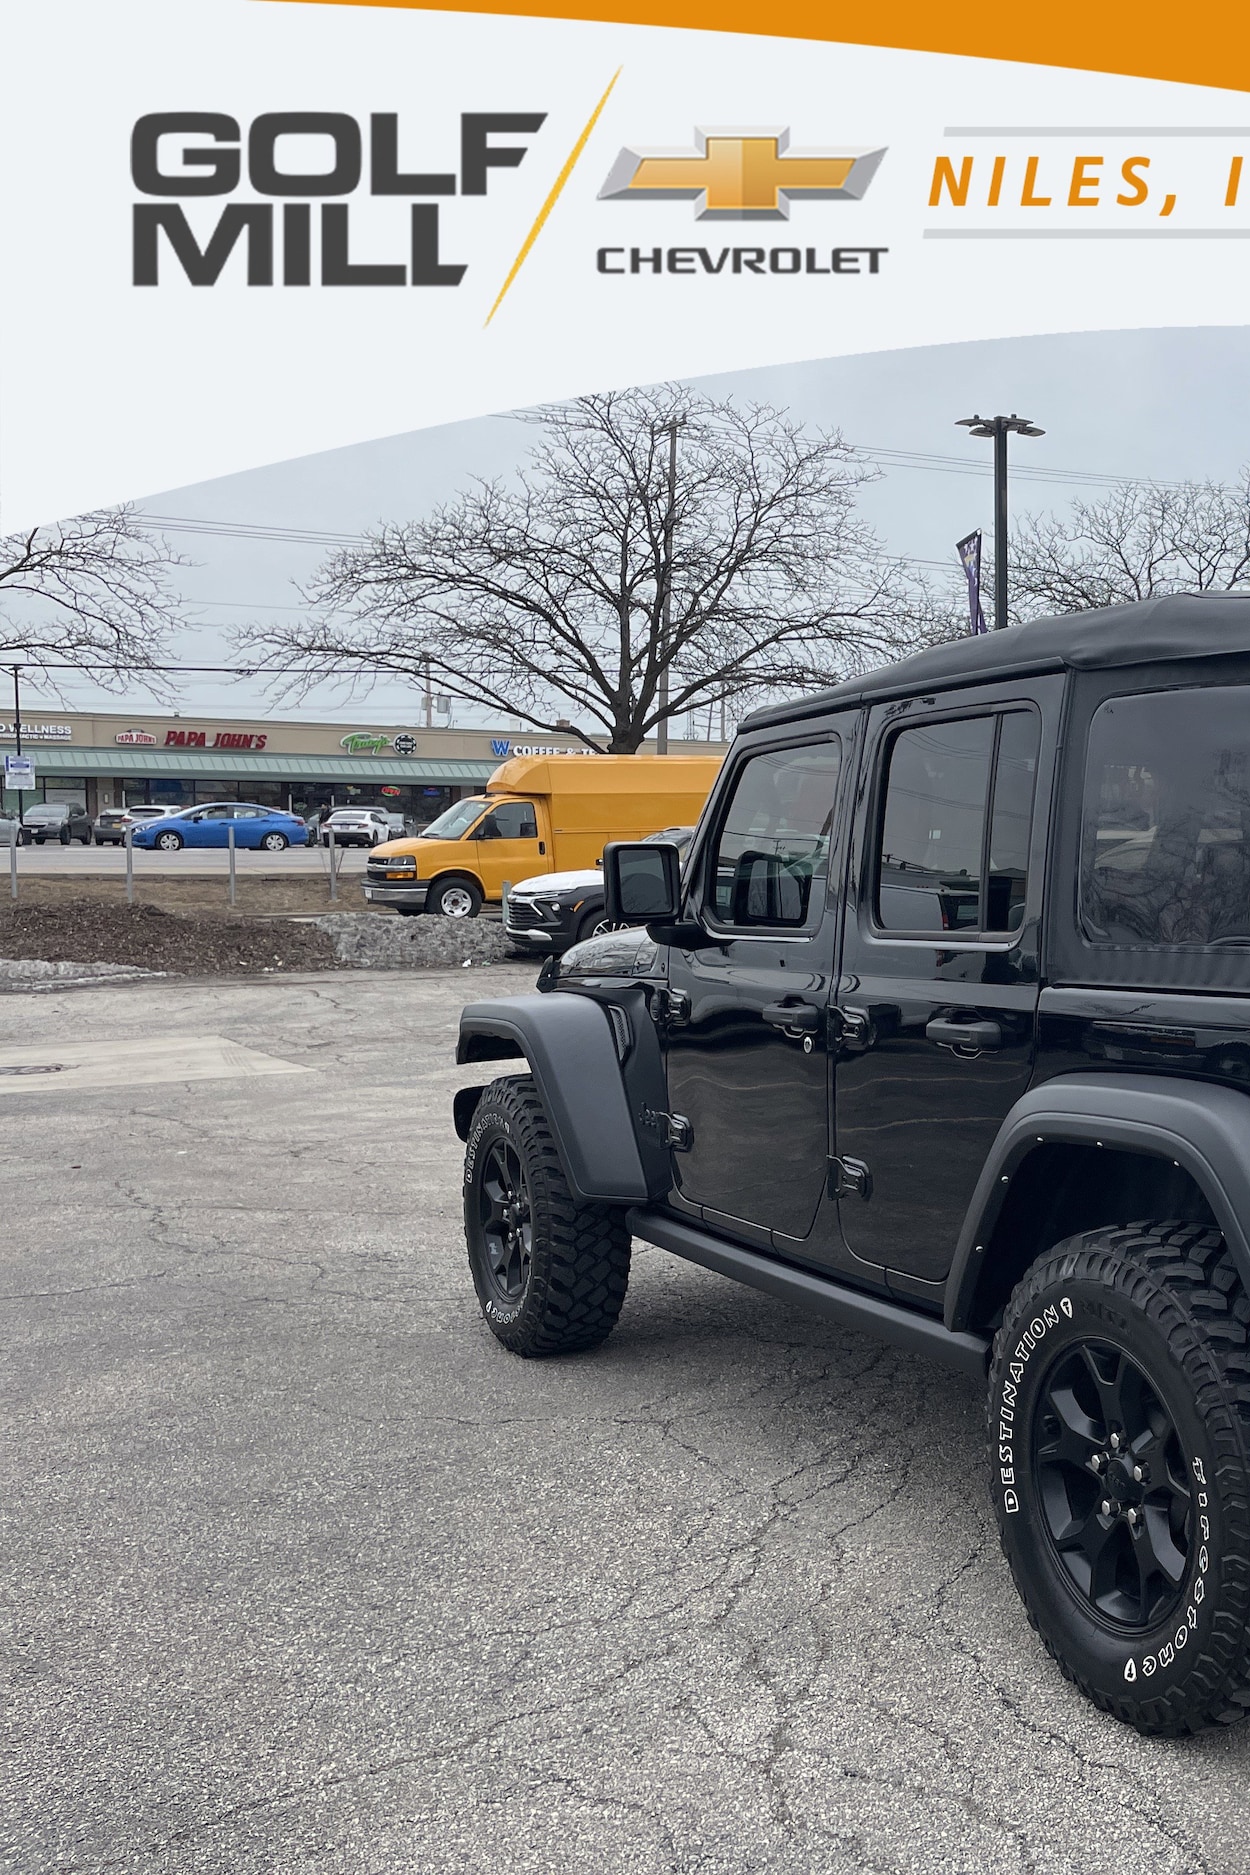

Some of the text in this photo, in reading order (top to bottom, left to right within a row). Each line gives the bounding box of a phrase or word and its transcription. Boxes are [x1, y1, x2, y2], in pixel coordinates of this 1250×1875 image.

[117, 733, 134, 743] PAPA
[164, 730, 268, 750] PAPA JOHN'S
[491, 739, 511, 757] W
[1000, 1306, 1059, 1514] DESTINATION
